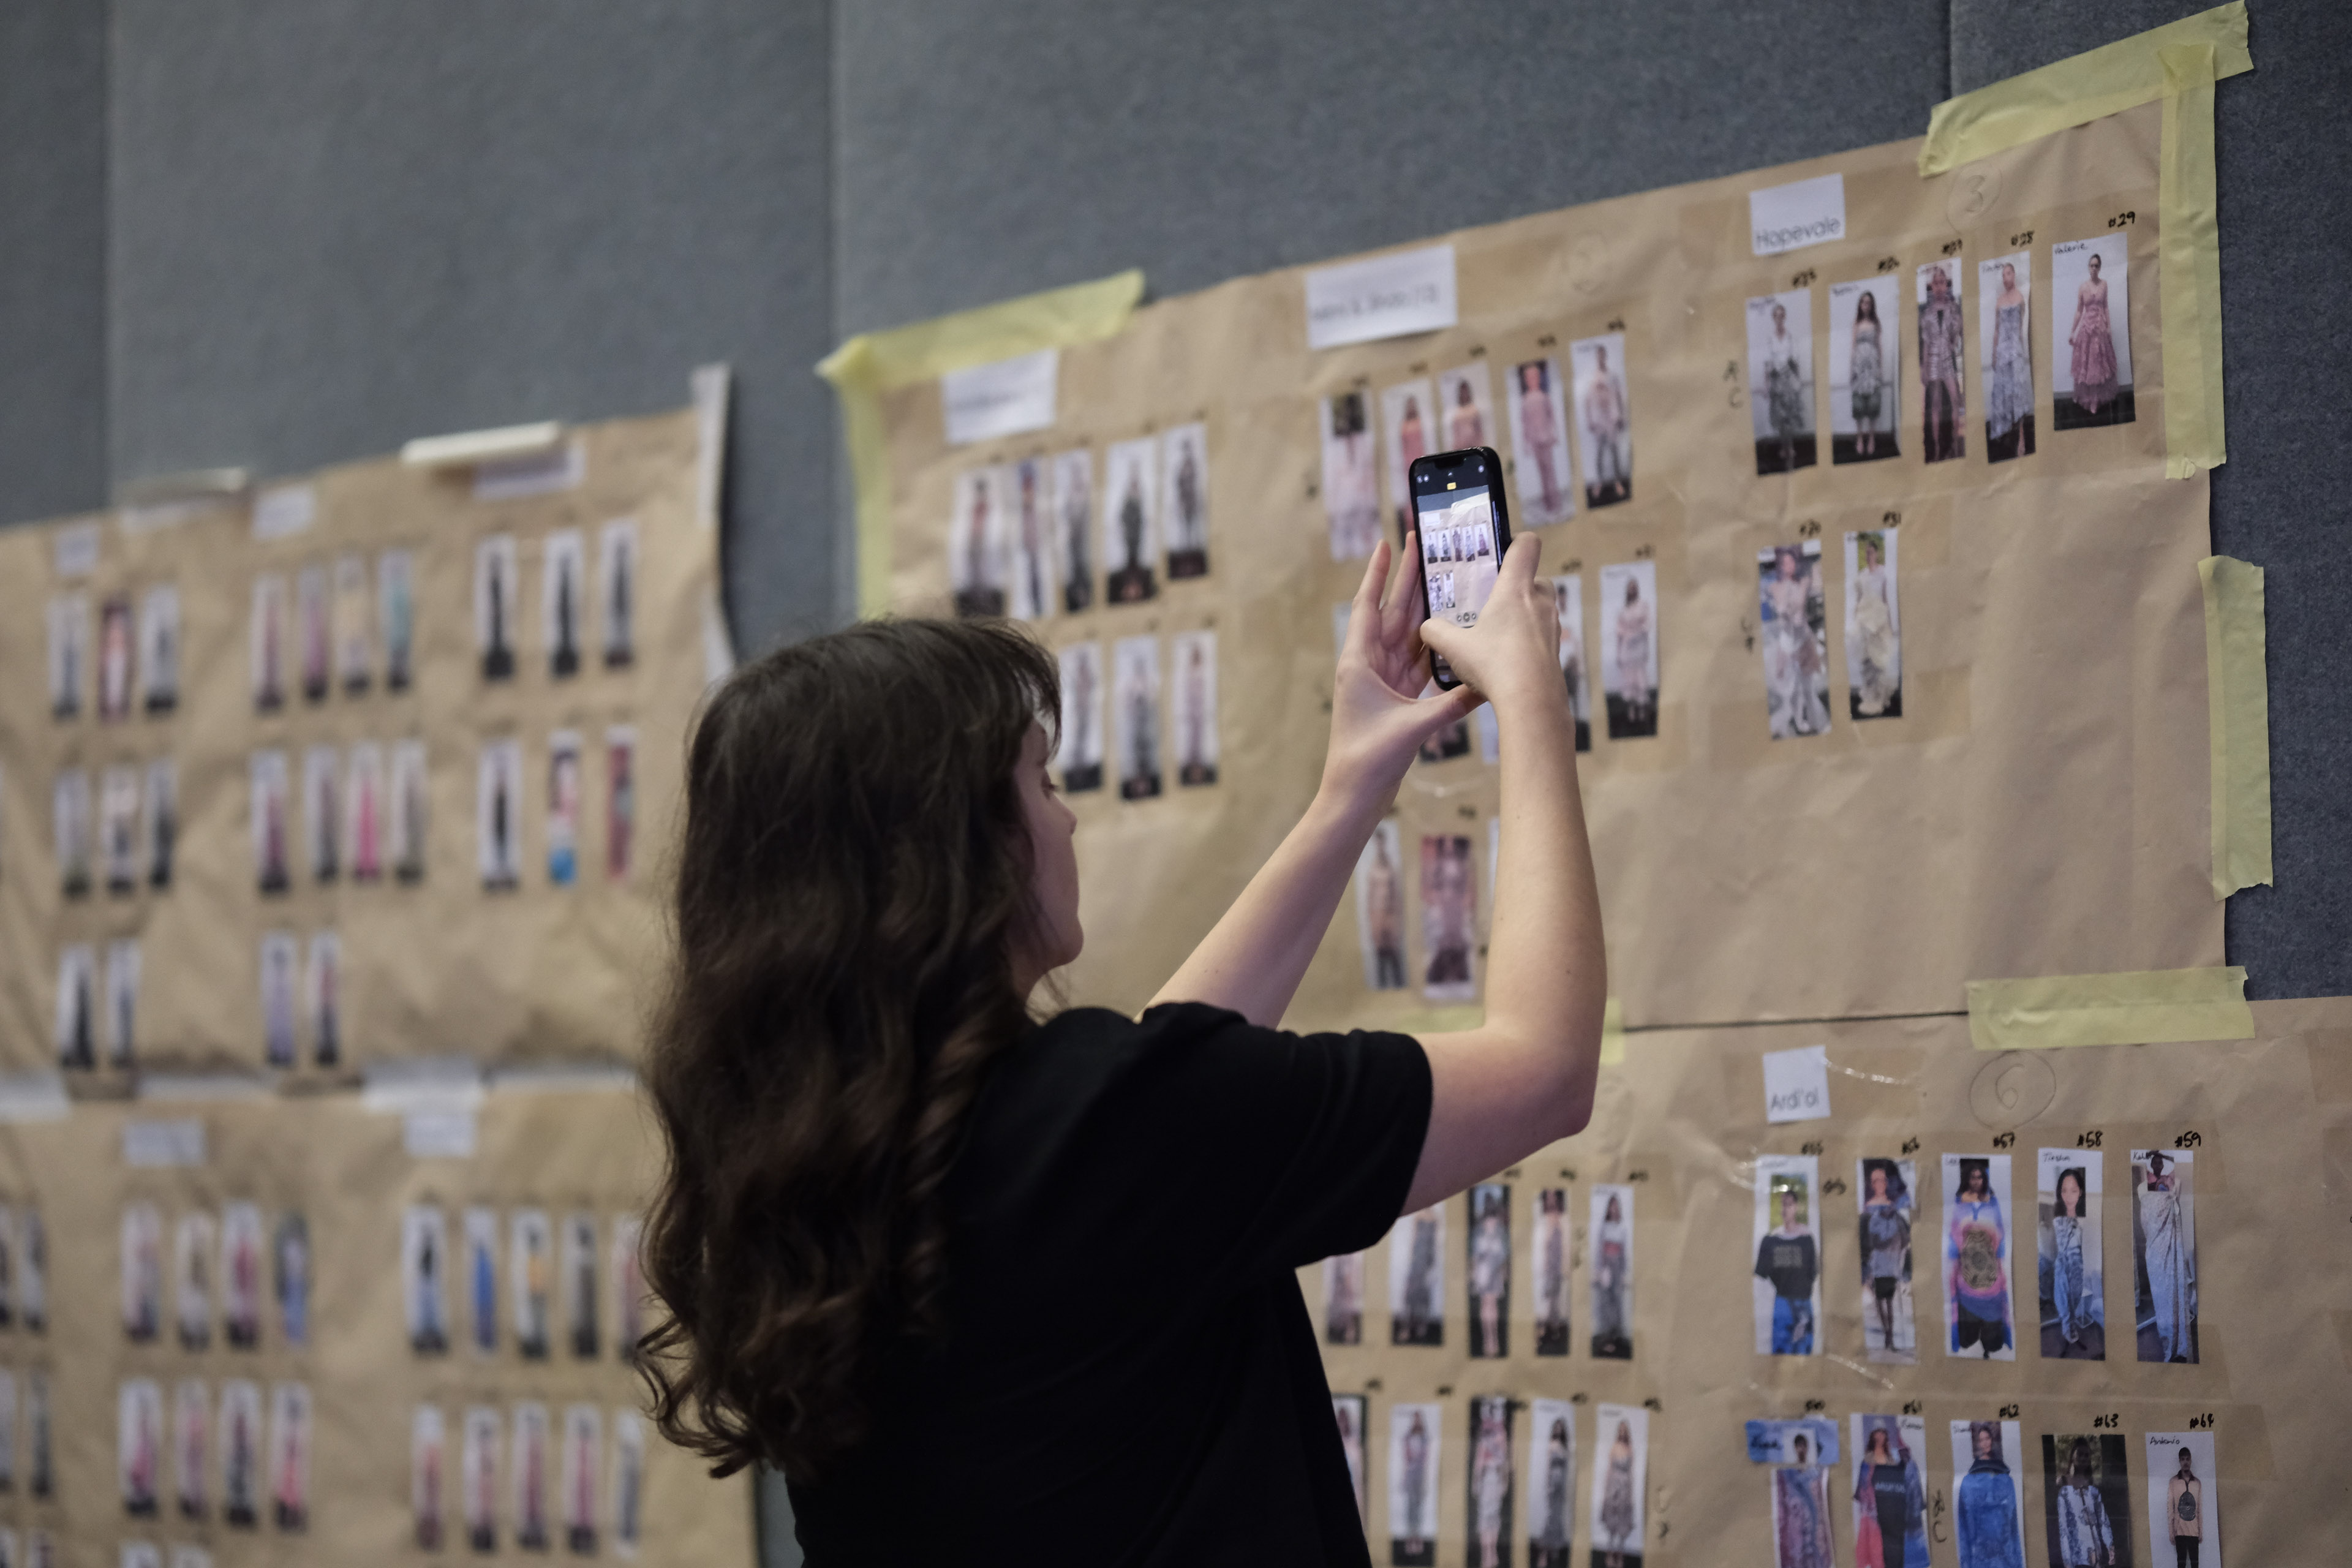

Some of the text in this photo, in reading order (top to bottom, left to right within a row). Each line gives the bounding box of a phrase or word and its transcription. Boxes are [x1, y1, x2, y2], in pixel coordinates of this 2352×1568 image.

[2108, 211, 2135, 228] #29
[1996, 1063, 2025, 1110] 6
[2077, 1131, 2103, 1147] #58
[2174, 1131, 2201, 1148] #59
[2094, 1414, 2119, 1429] #63
[2190, 1413, 2214, 1430] #64
